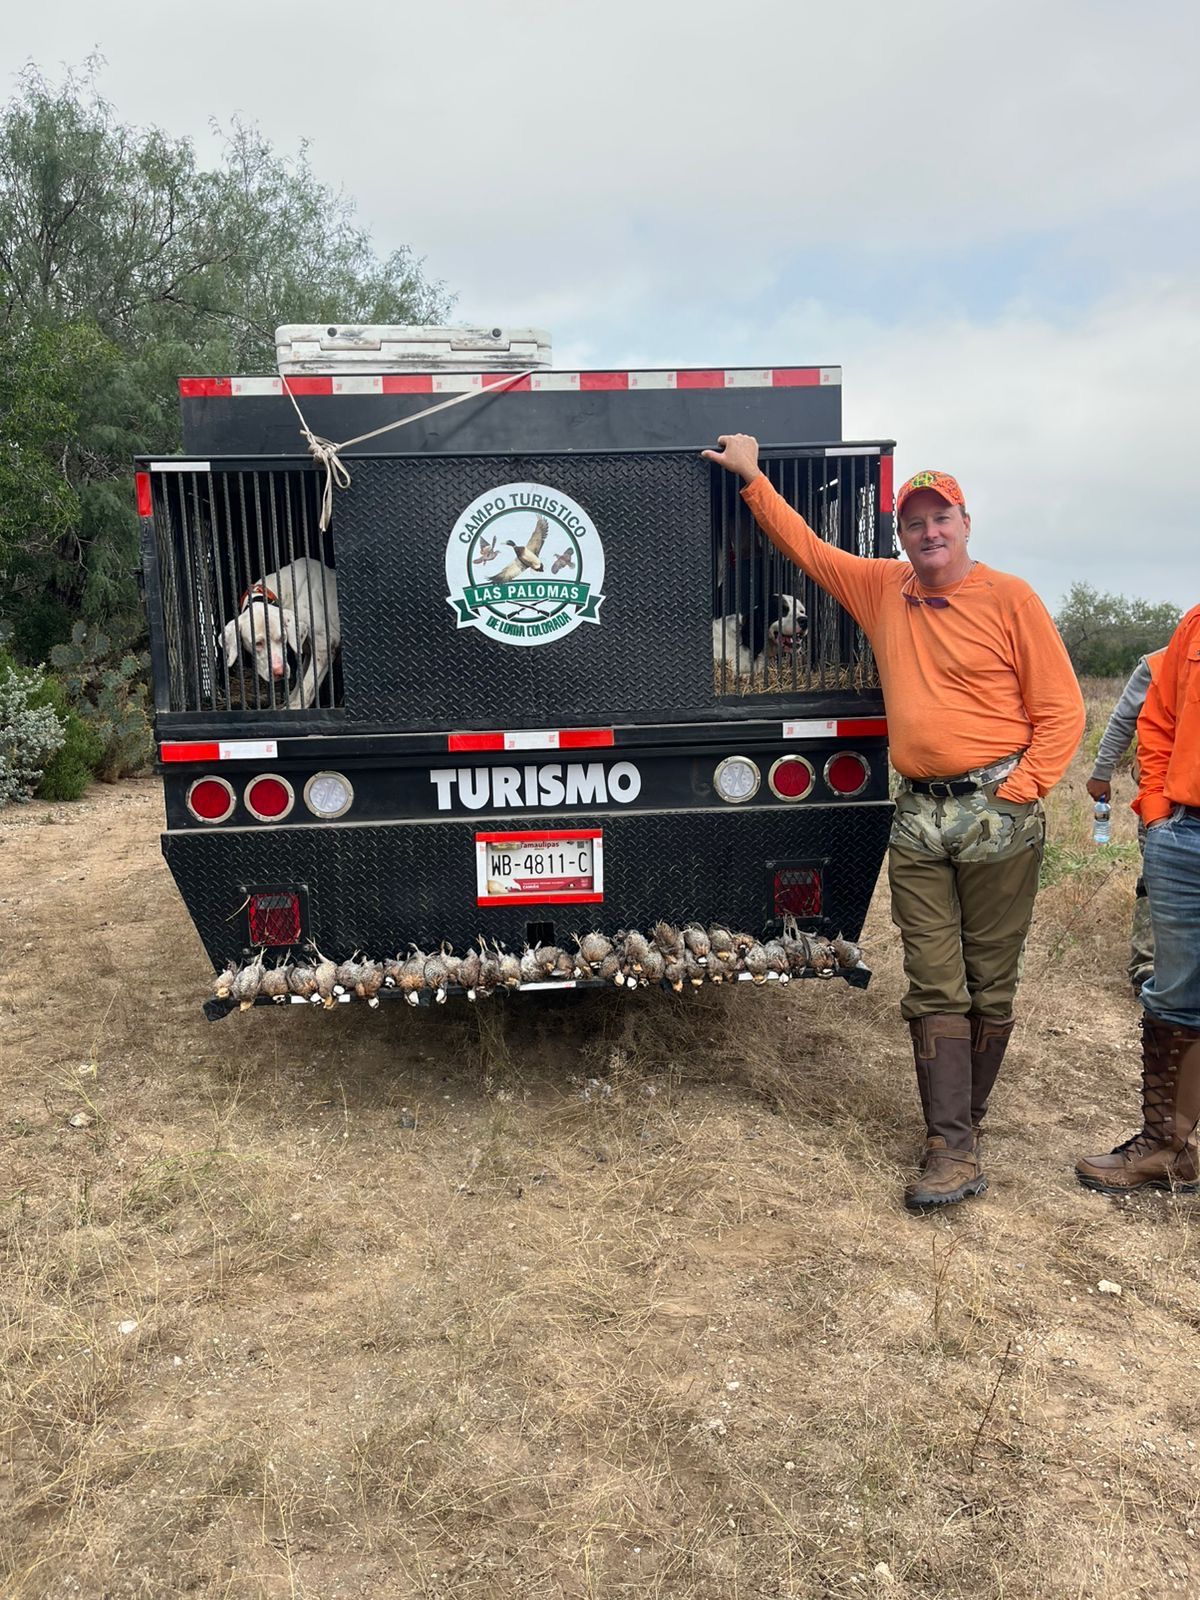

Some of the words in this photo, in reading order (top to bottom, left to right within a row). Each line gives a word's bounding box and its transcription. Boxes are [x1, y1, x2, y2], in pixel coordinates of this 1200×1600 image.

[459, 498, 506, 544] CAMPO
[509, 493, 587, 538] TURISTICO
[474, 587, 501, 602] LAS
[508, 584, 579, 600] PALOMAS
[486, 615, 499, 630] DE
[498, 623, 525, 637] LOMA
[527, 611, 572, 637] COLORADA
[430, 761, 641, 810] TURISMO
[520, 841, 560, 849] Tamaulipas
[491, 852, 588, 876] WB-4811-C
